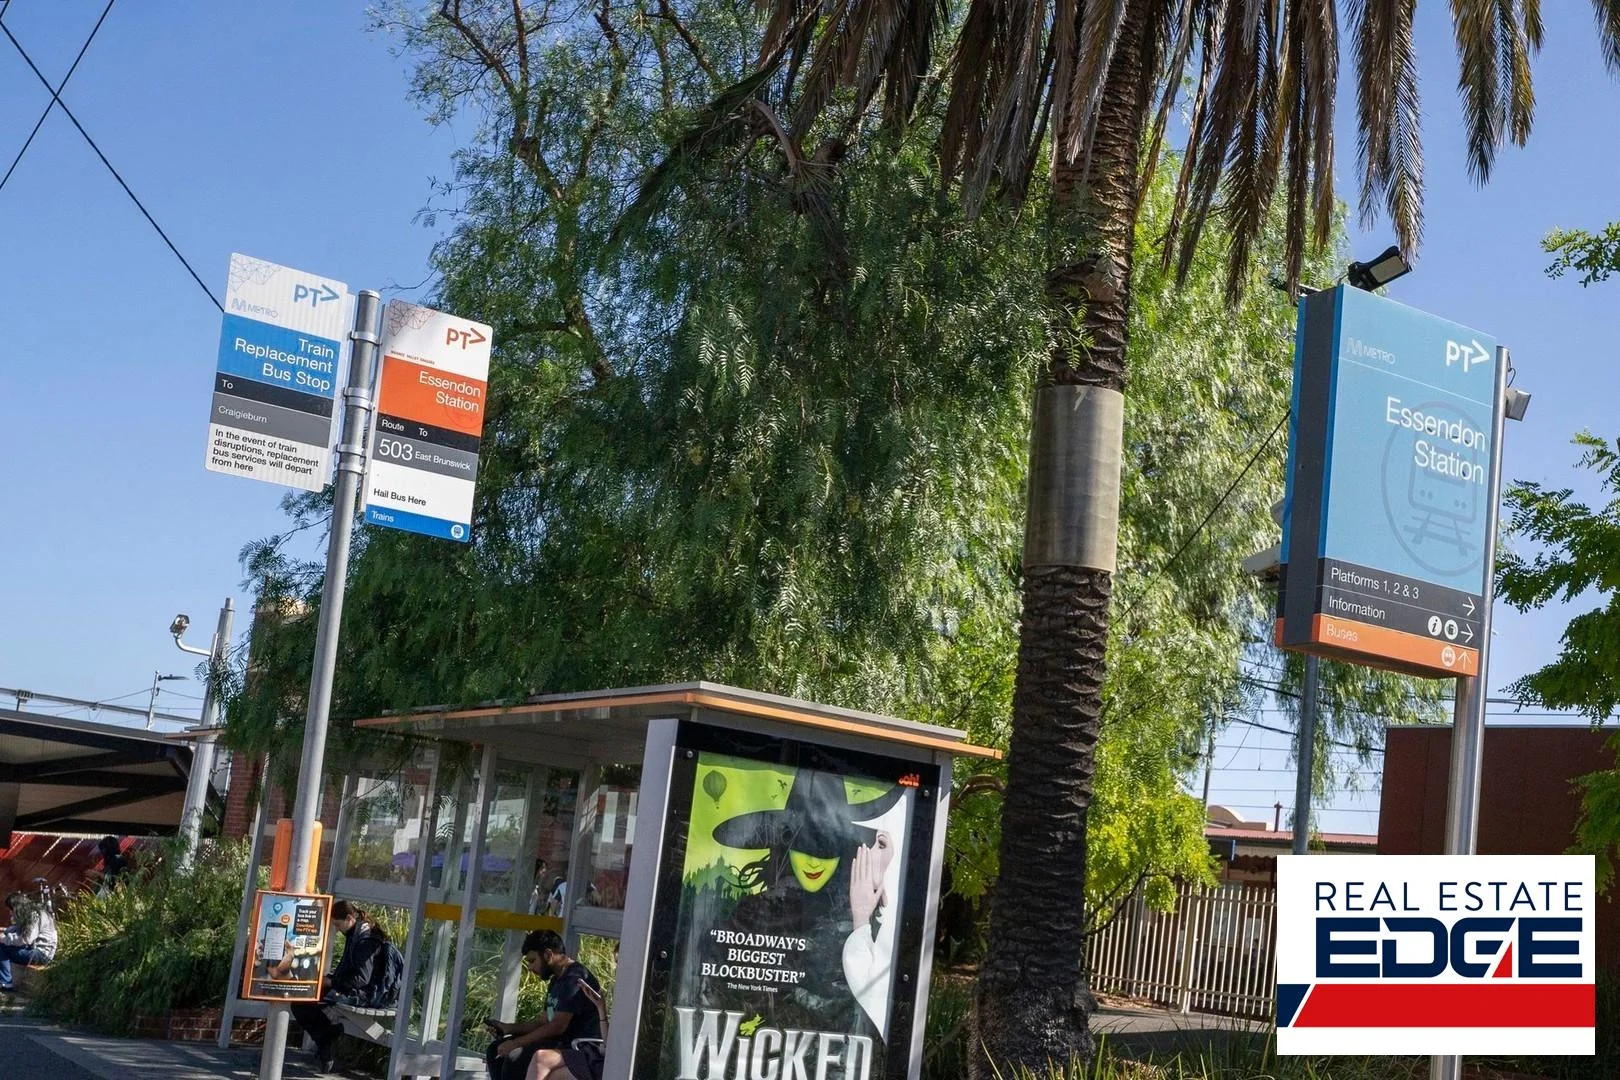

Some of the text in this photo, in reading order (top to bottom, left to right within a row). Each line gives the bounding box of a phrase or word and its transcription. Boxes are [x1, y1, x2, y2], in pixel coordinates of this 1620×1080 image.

[248, 304, 279, 318] METRO
[235, 338, 332, 374] Replacement
[299, 338, 334, 359] Train
[1363, 346, 1396, 365] METRO
[222, 379, 234, 389] To
[263, 363, 330, 392] Bus Stop
[419, 370, 481, 397] Essendon
[436, 391, 479, 412] Station
[218, 405, 268, 423] Craigieburn
[1386, 395, 1486, 453] Essendon
[381, 419, 428, 437] Route To
[215, 429, 224, 437] In
[226, 431, 239, 441] the
[242, 436, 266, 446] event
[278, 442, 297, 453] train
[213, 447, 312, 475] bus services will depart
[214, 438, 319, 467] disruptions, replacement
[379, 438, 471, 470] 503 East Brunswick
[1414, 440, 1484, 485] Station
[212, 456, 253, 472] from here
[373, 488, 426, 506] Hail Bus Here
[372, 510, 394, 523] Trains
[1331, 567, 1419, 599] Platforms 1, 2 & 3
[1329, 596, 1386, 620] Information
[1326, 624, 1358, 642] Buses
[727, 948, 785, 966] BIGGEST
